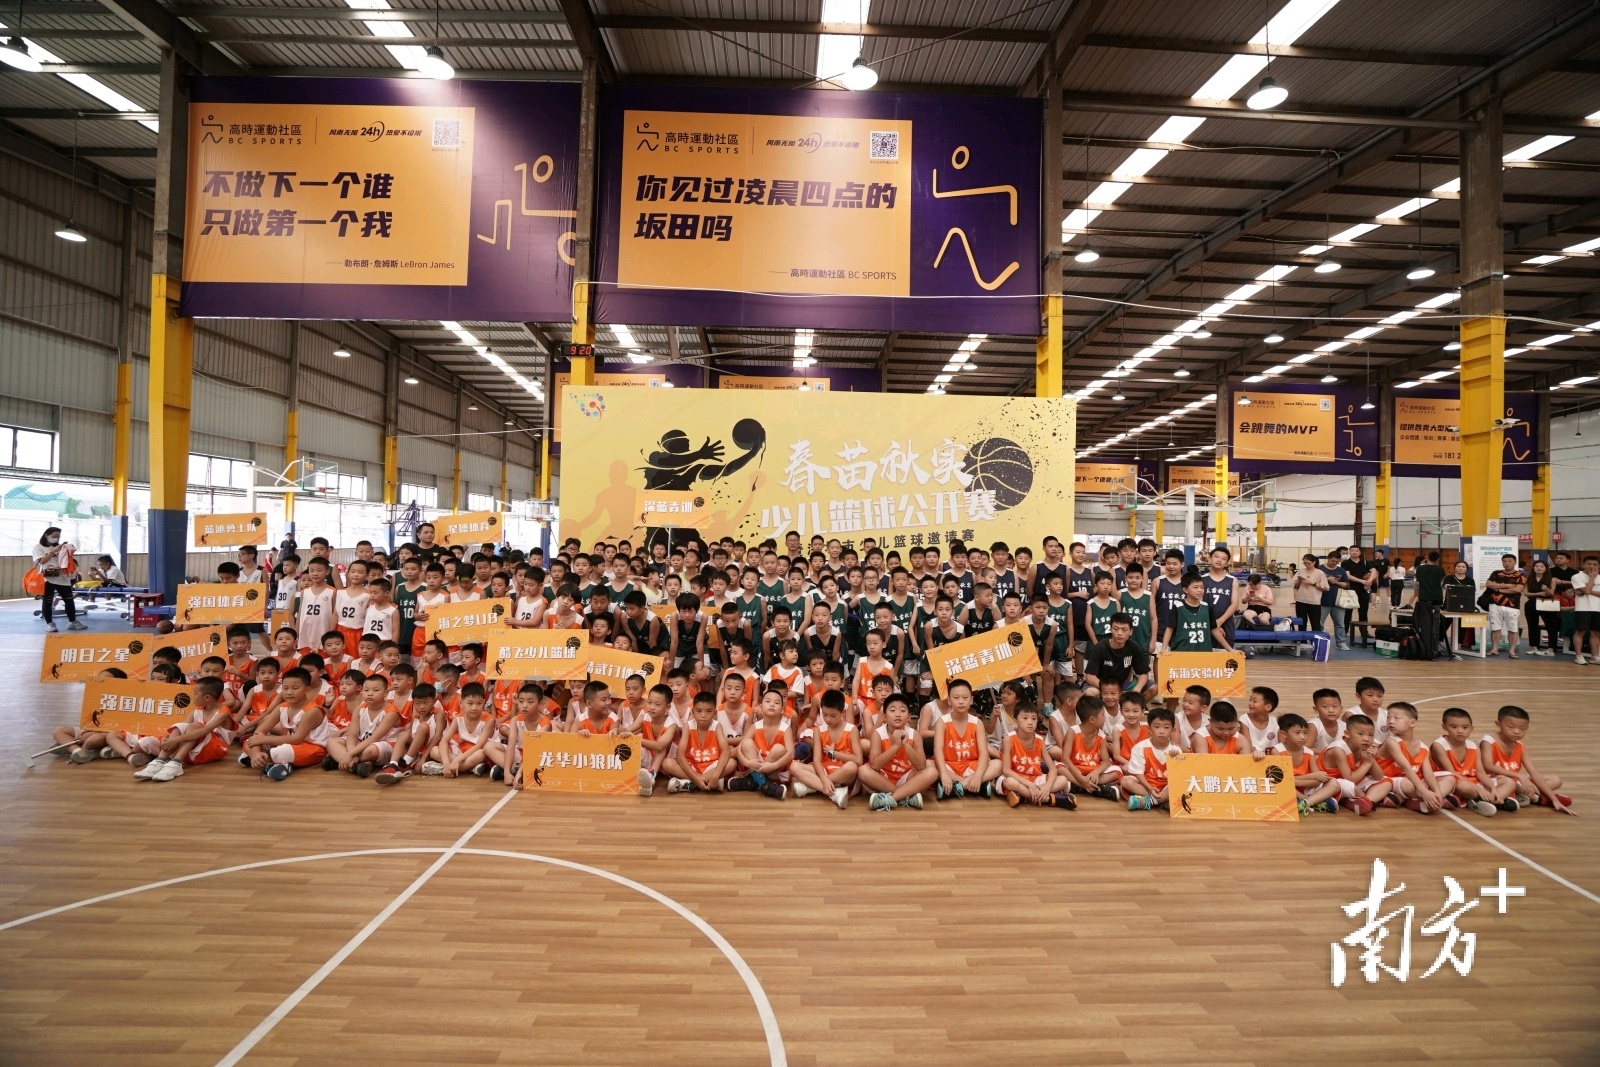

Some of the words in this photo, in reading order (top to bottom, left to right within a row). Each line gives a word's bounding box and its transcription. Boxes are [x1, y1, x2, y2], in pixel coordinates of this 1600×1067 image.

[229, 124, 302, 136] 高時運動社區
[252, 137, 302, 145] SPORTS
[664, 131, 739, 146] 高時運動社區
[664, 145, 679, 153] BC
[688, 145, 739, 155] SPORTS
[202, 169, 394, 199] 不做下一个谁
[635, 174, 898, 209] 你见过凌晨四点的
[200, 208, 393, 238] 只做第一个我
[633, 212, 734, 242] 坂田吗
[400, 260, 428, 269] LeBron
[429, 261, 455, 269] James
[790, 268, 846, 279] 高時運動社區
[848, 270, 860, 279] BC
[861, 271, 897, 280] SPORTS
[778, 438, 975, 496] 春苗秋实
[643, 500, 694, 513] 深蓝青训
[760, 488, 998, 539] 少儿篮球公开赛
[188, 594, 245, 609] 强国体育
[278, 592, 288, 601] 30
[1212, 594, 1220, 605] 7
[306, 604, 321, 616] 26
[341, 606, 356, 618] 62
[403, 608, 414, 619] 10
[370, 620, 384, 632] 25
[1188, 630, 1205, 644] 23
[60, 647, 130, 664] 明日之星
[498, 646, 577, 660] 酷飞少儿篮球
[944, 641, 1013, 676] 深蓝青训
[1168, 667, 1235, 679] 东海实验小学
[99, 693, 175, 716] 强国体育
[502, 701, 509, 712] 5
[539, 751, 623, 770] 龙华小狼队
[1185, 775, 1278, 794] 大鹏大魔王
